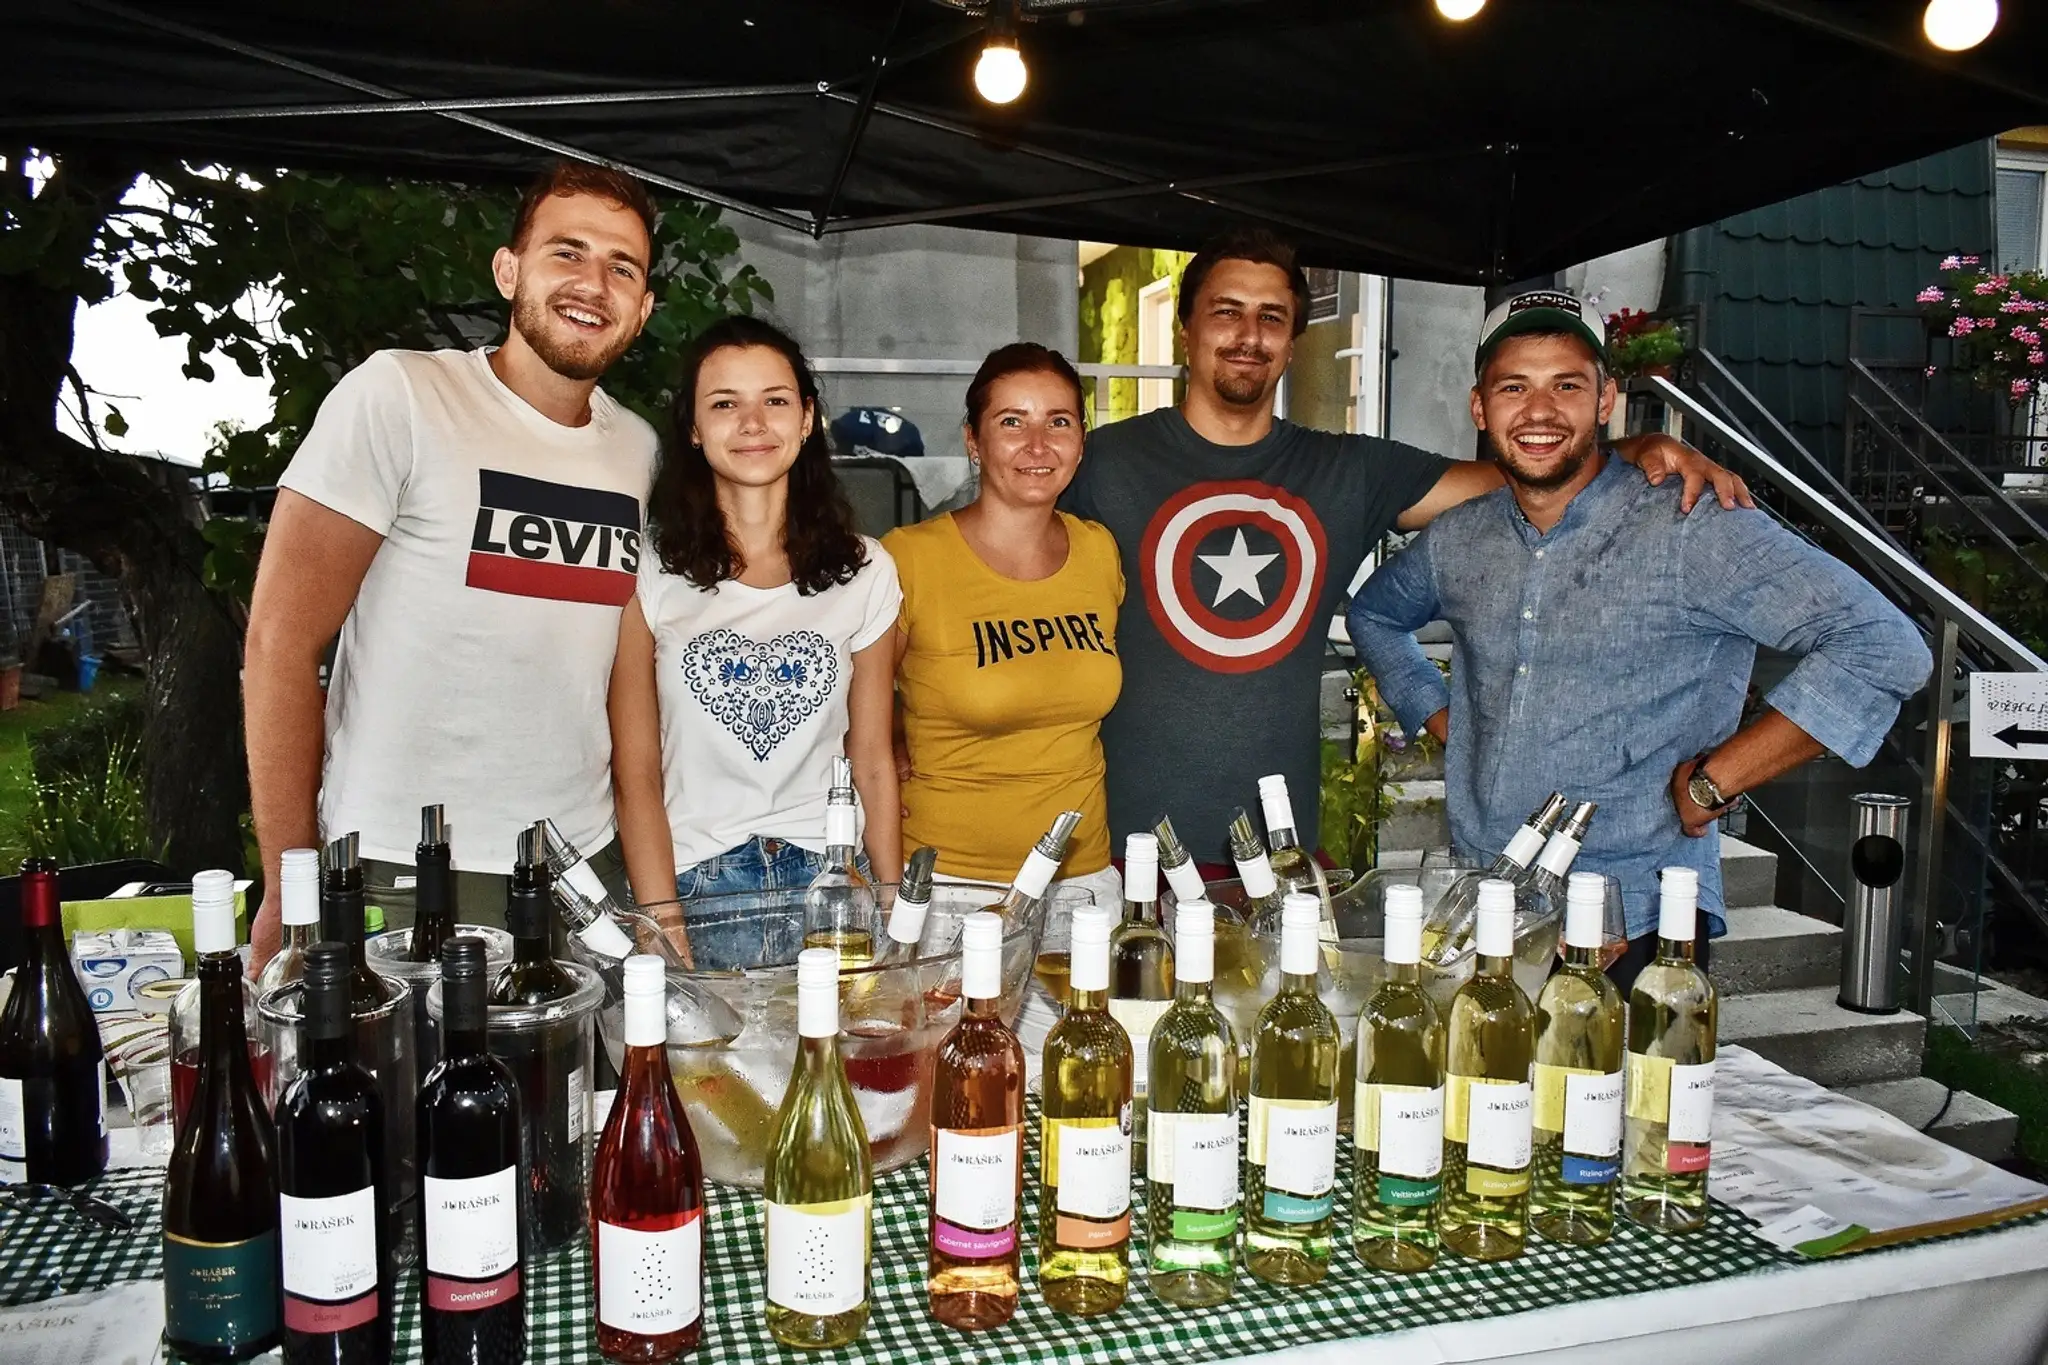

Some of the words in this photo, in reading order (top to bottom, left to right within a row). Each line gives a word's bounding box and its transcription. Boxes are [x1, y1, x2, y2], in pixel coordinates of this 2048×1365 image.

[972, 613, 1116, 669] INSPIRE
[938, 1234, 972, 1249] Cabernet
[973, 1236, 1011, 1250] sauvignon
[450, 1288, 499, 1303] Dornfelder
